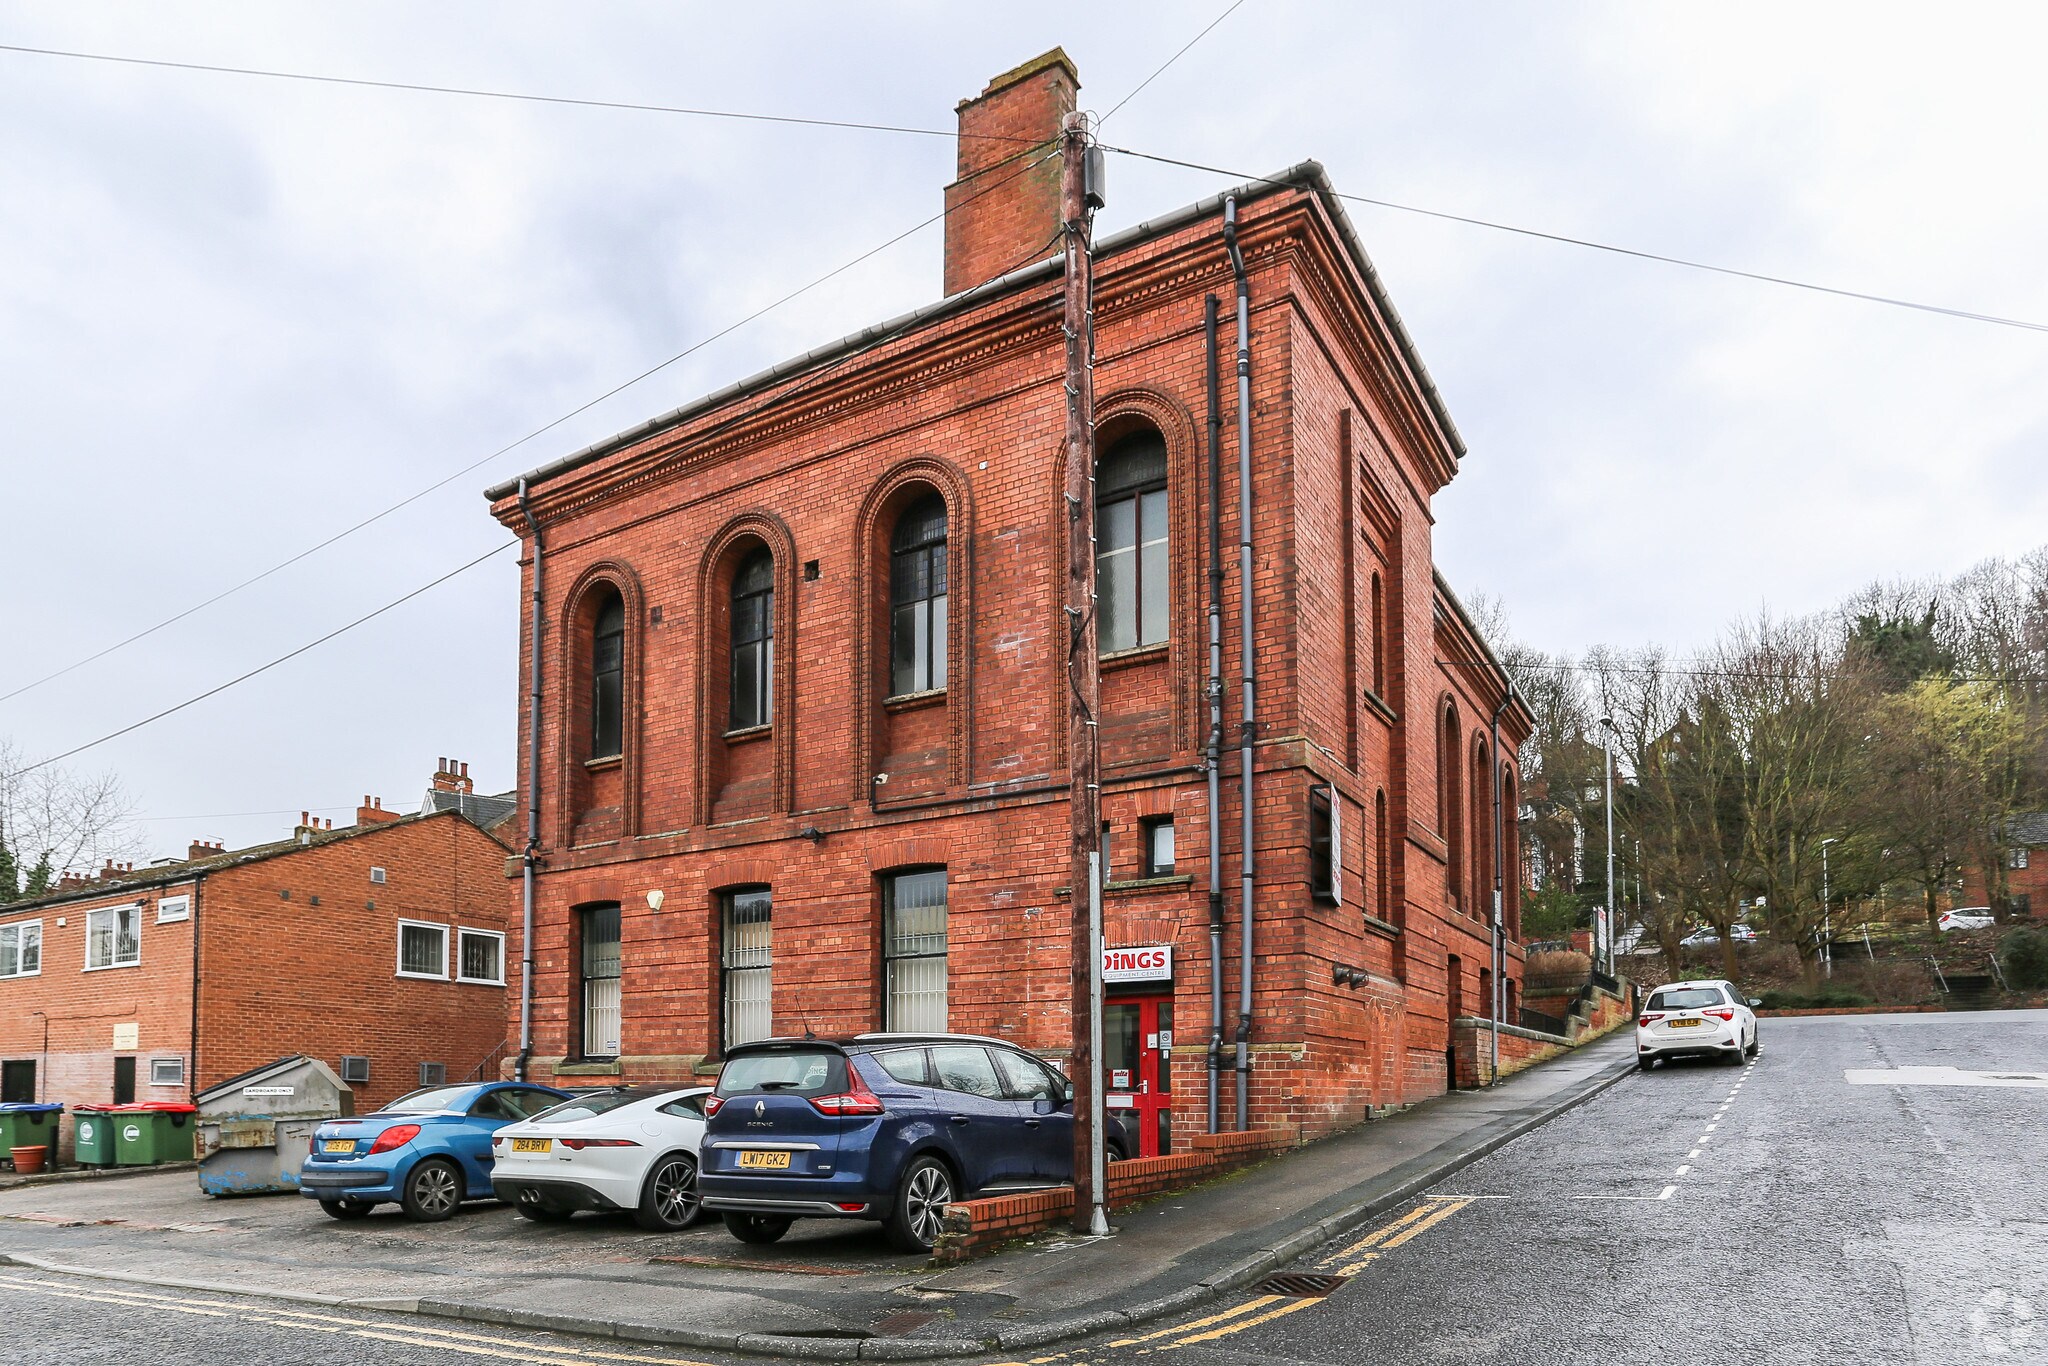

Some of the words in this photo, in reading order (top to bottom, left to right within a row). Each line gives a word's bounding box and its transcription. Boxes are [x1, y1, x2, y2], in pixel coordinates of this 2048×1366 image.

[516, 1139, 530, 1150] 284
[531, 1139, 546, 1151] BRV
[743, 1153, 765, 1165] LW17
[766, 1153, 787, 1166] GKZ
